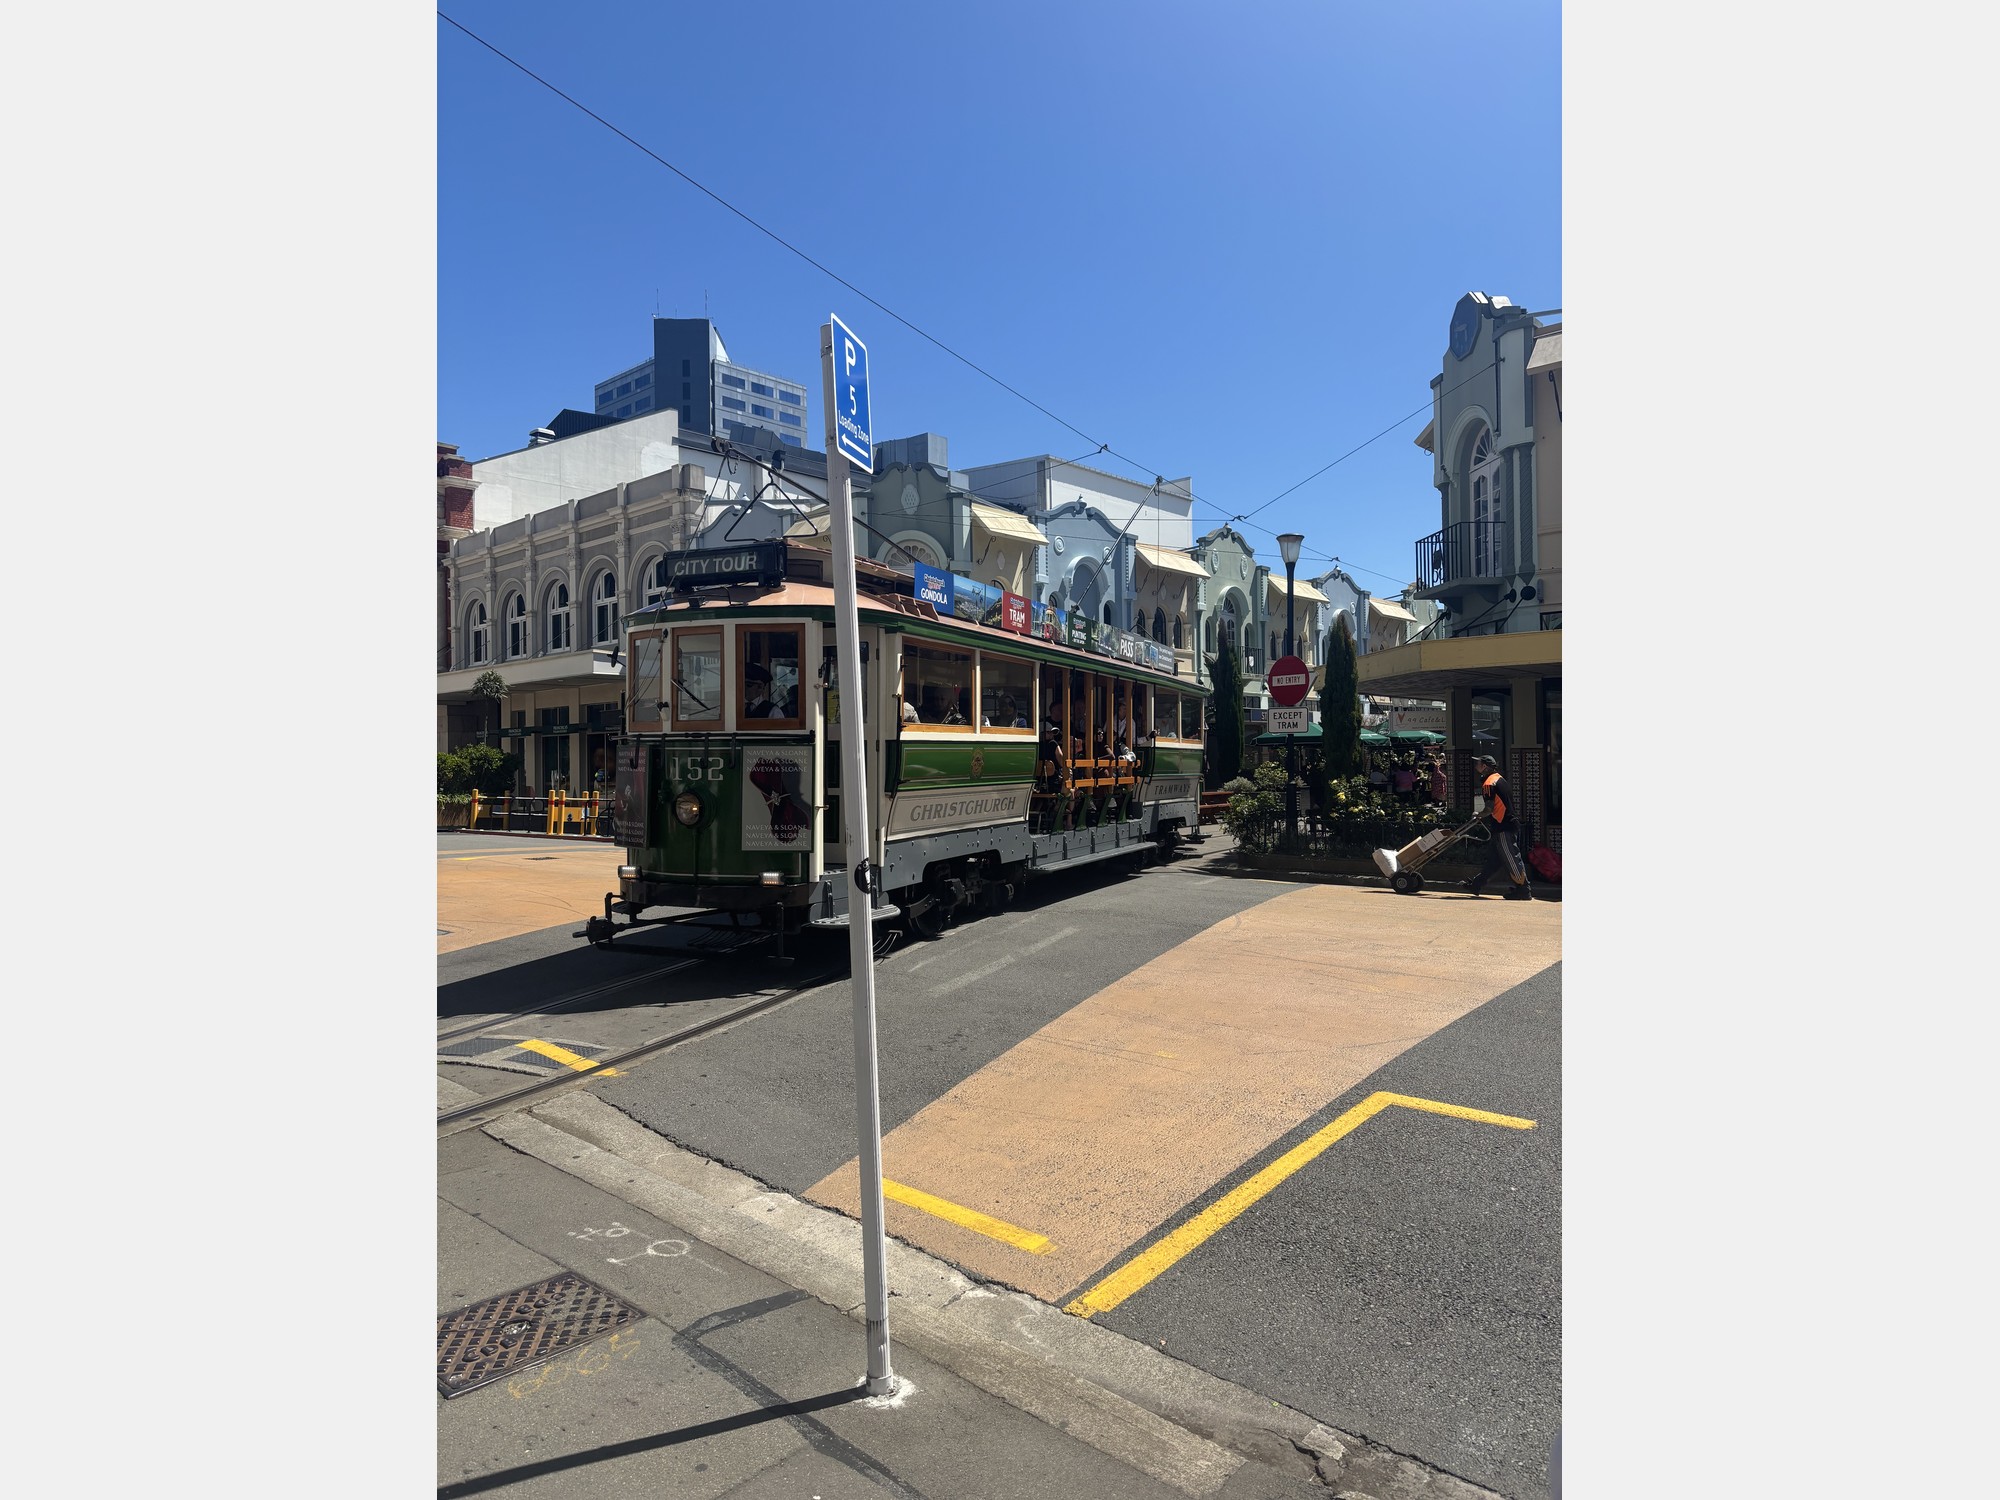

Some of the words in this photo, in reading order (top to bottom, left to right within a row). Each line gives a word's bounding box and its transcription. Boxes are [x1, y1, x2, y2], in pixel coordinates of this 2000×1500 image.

[845, 337, 856, 376] P
[850, 385, 857, 416] 5
[839, 410, 858, 439] Loading
[858, 424, 869, 445] Zone
[674, 558, 710, 576] CITY
[713, 554, 757, 573] TOUR
[920, 588, 948, 605] GONDOLA
[1009, 608, 1025, 624] TRAM
[1120, 638, 1134, 658] PASS
[1277, 677, 1284, 685] NO
[1285, 676, 1301, 684] ENTRY
[1273, 711, 1303, 720] EXCEPT
[1277, 722, 1299, 730] TRAM
[672, 757, 724, 781] 152
[910, 796, 1016, 822] CHRISTCHURCH
